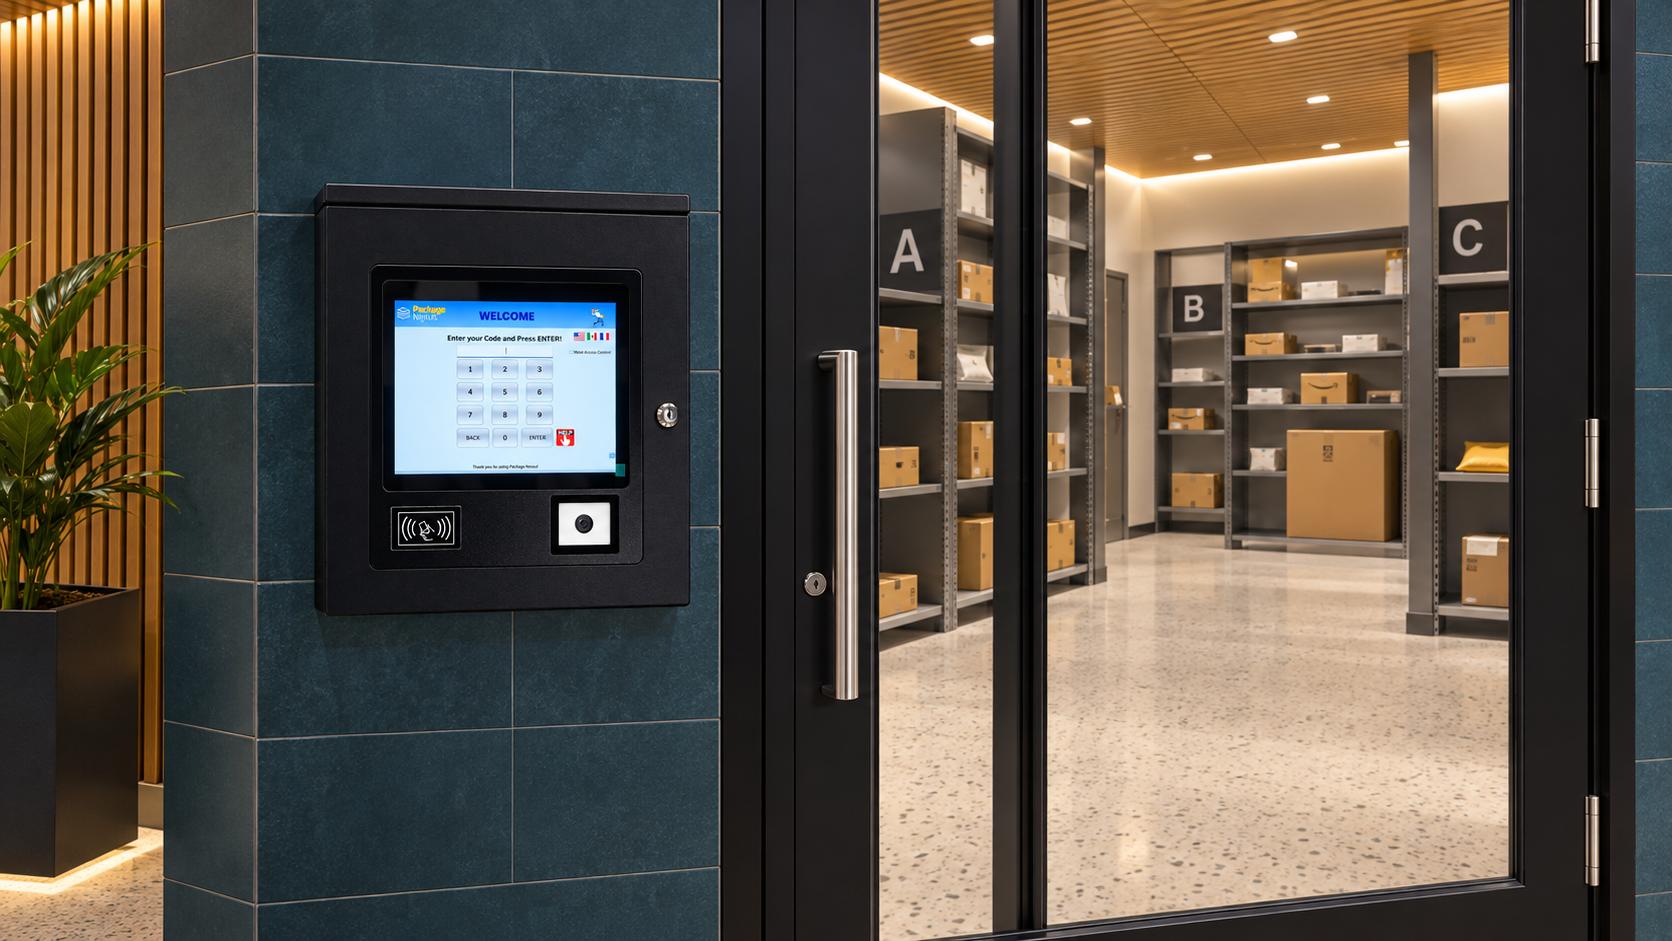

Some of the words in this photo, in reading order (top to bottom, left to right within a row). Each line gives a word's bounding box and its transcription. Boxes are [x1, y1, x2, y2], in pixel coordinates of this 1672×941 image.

[1452, 218, 1483, 257] C
[890, 227, 925, 274] A
[1183, 294, 1205, 322] B
[479, 311, 535, 321] WELCOME
[447, 334, 465, 342] Enter
[484, 334, 501, 342] Code
[503, 334, 516, 342] and
[517, 334, 536, 342] Press
[468, 365, 473, 373] 1
[502, 365, 508, 373] 2
[537, 365, 543, 373] 3
[502, 388, 508, 396] 5
[537, 388, 543, 396] 6
[467, 411, 473, 419] 7
